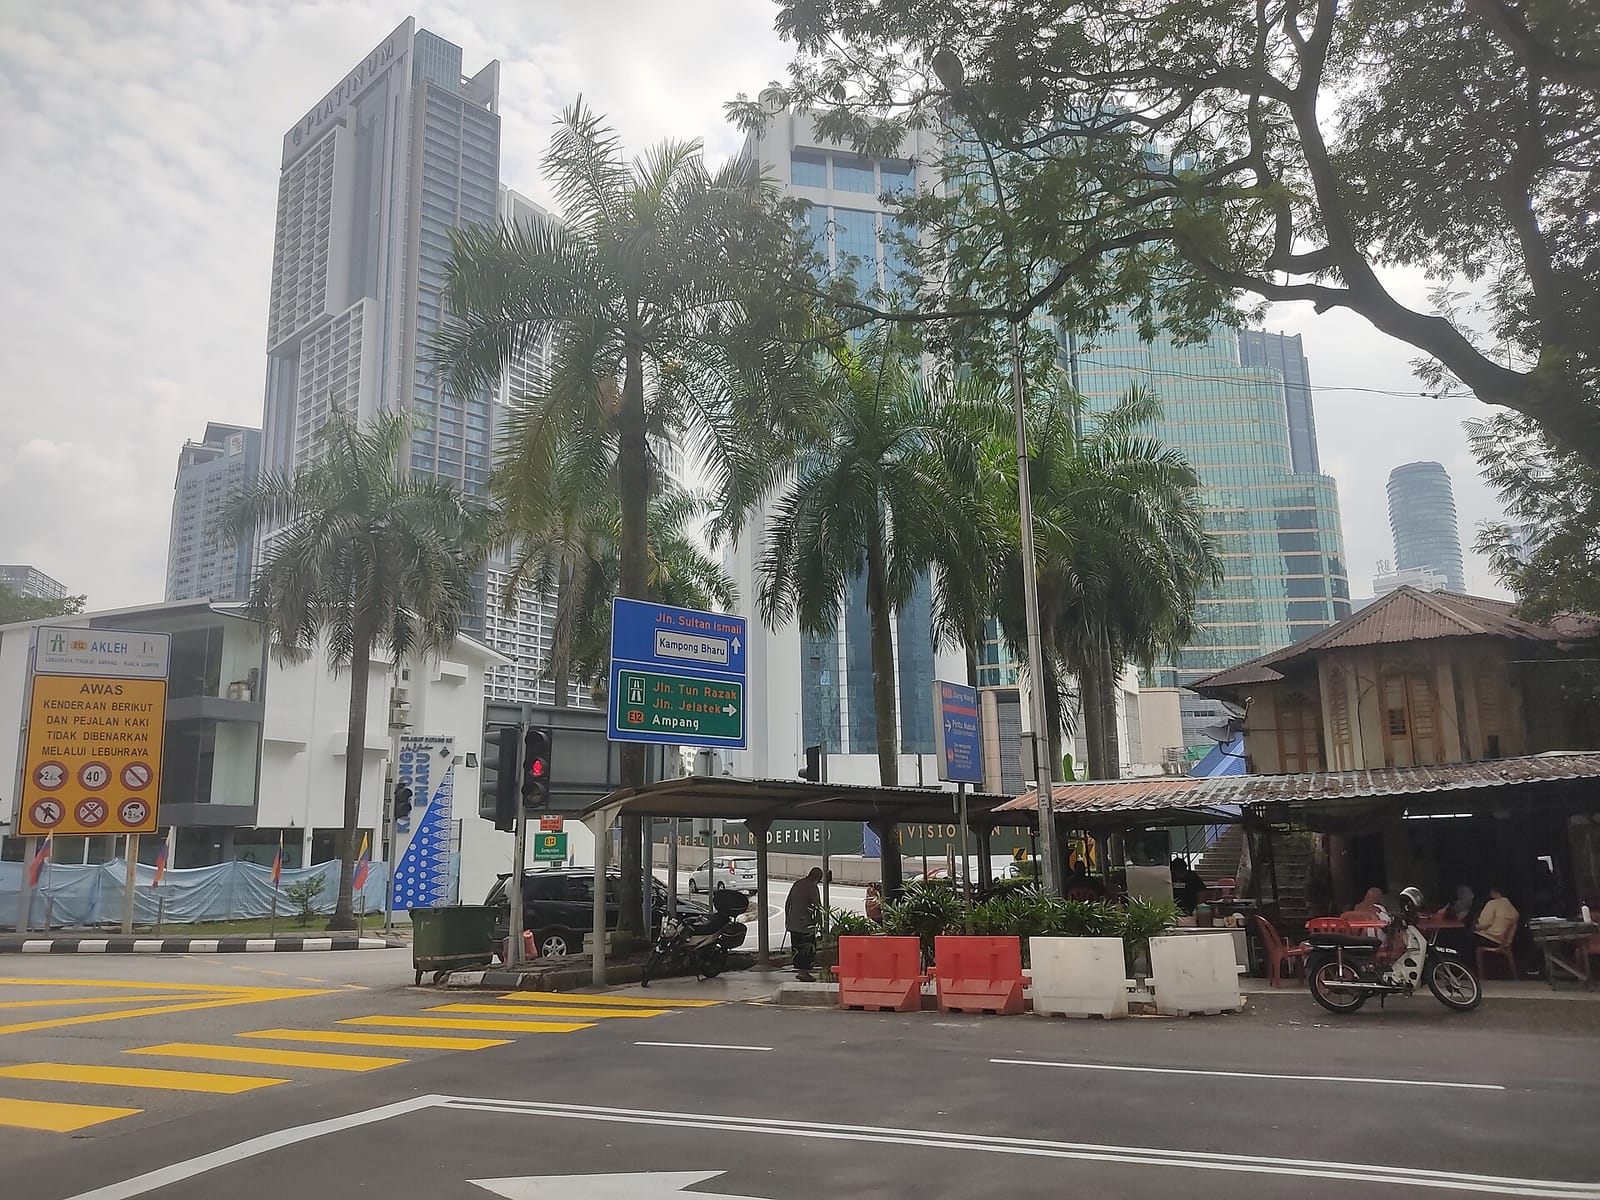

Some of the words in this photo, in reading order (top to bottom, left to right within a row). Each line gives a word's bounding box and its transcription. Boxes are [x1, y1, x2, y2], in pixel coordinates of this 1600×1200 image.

[306, 38, 394, 135] PLATINUM
[655, 612, 675, 625] Jln.
[678, 615, 711, 631] Sultan
[713, 621, 742, 635] Ismail
[91, 641, 128, 654] AKLEH
[659, 638, 699, 654] Kampong
[701, 643, 725, 656] Bharu
[80, 683, 124, 696] AWAS
[653, 681, 674, 694] Jln.
[678, 683, 699, 696] Tun
[704, 686, 737, 700] Razak
[43, 699, 107, 711] KENDERAAN
[111, 702, 153, 712] BERIKUT
[652, 698, 673, 710] Jln.
[678, 700, 721, 714] Jelatek
[46, 715, 68, 725] DAN
[73, 716, 119, 726] PEJALAN
[124, 718, 149, 727] KAKI
[629, 711, 642, 722] E12
[652, 714, 700, 731] Ampang
[47, 730, 77, 740] TIDAK
[83, 731, 148, 742] DIBENARKAN
[42, 746, 86, 756] MELALUI
[91, 747, 149, 757] LEBUHRAYA
[414, 753, 431, 807] BHARU
[907, 824, 969, 839] VISIO
